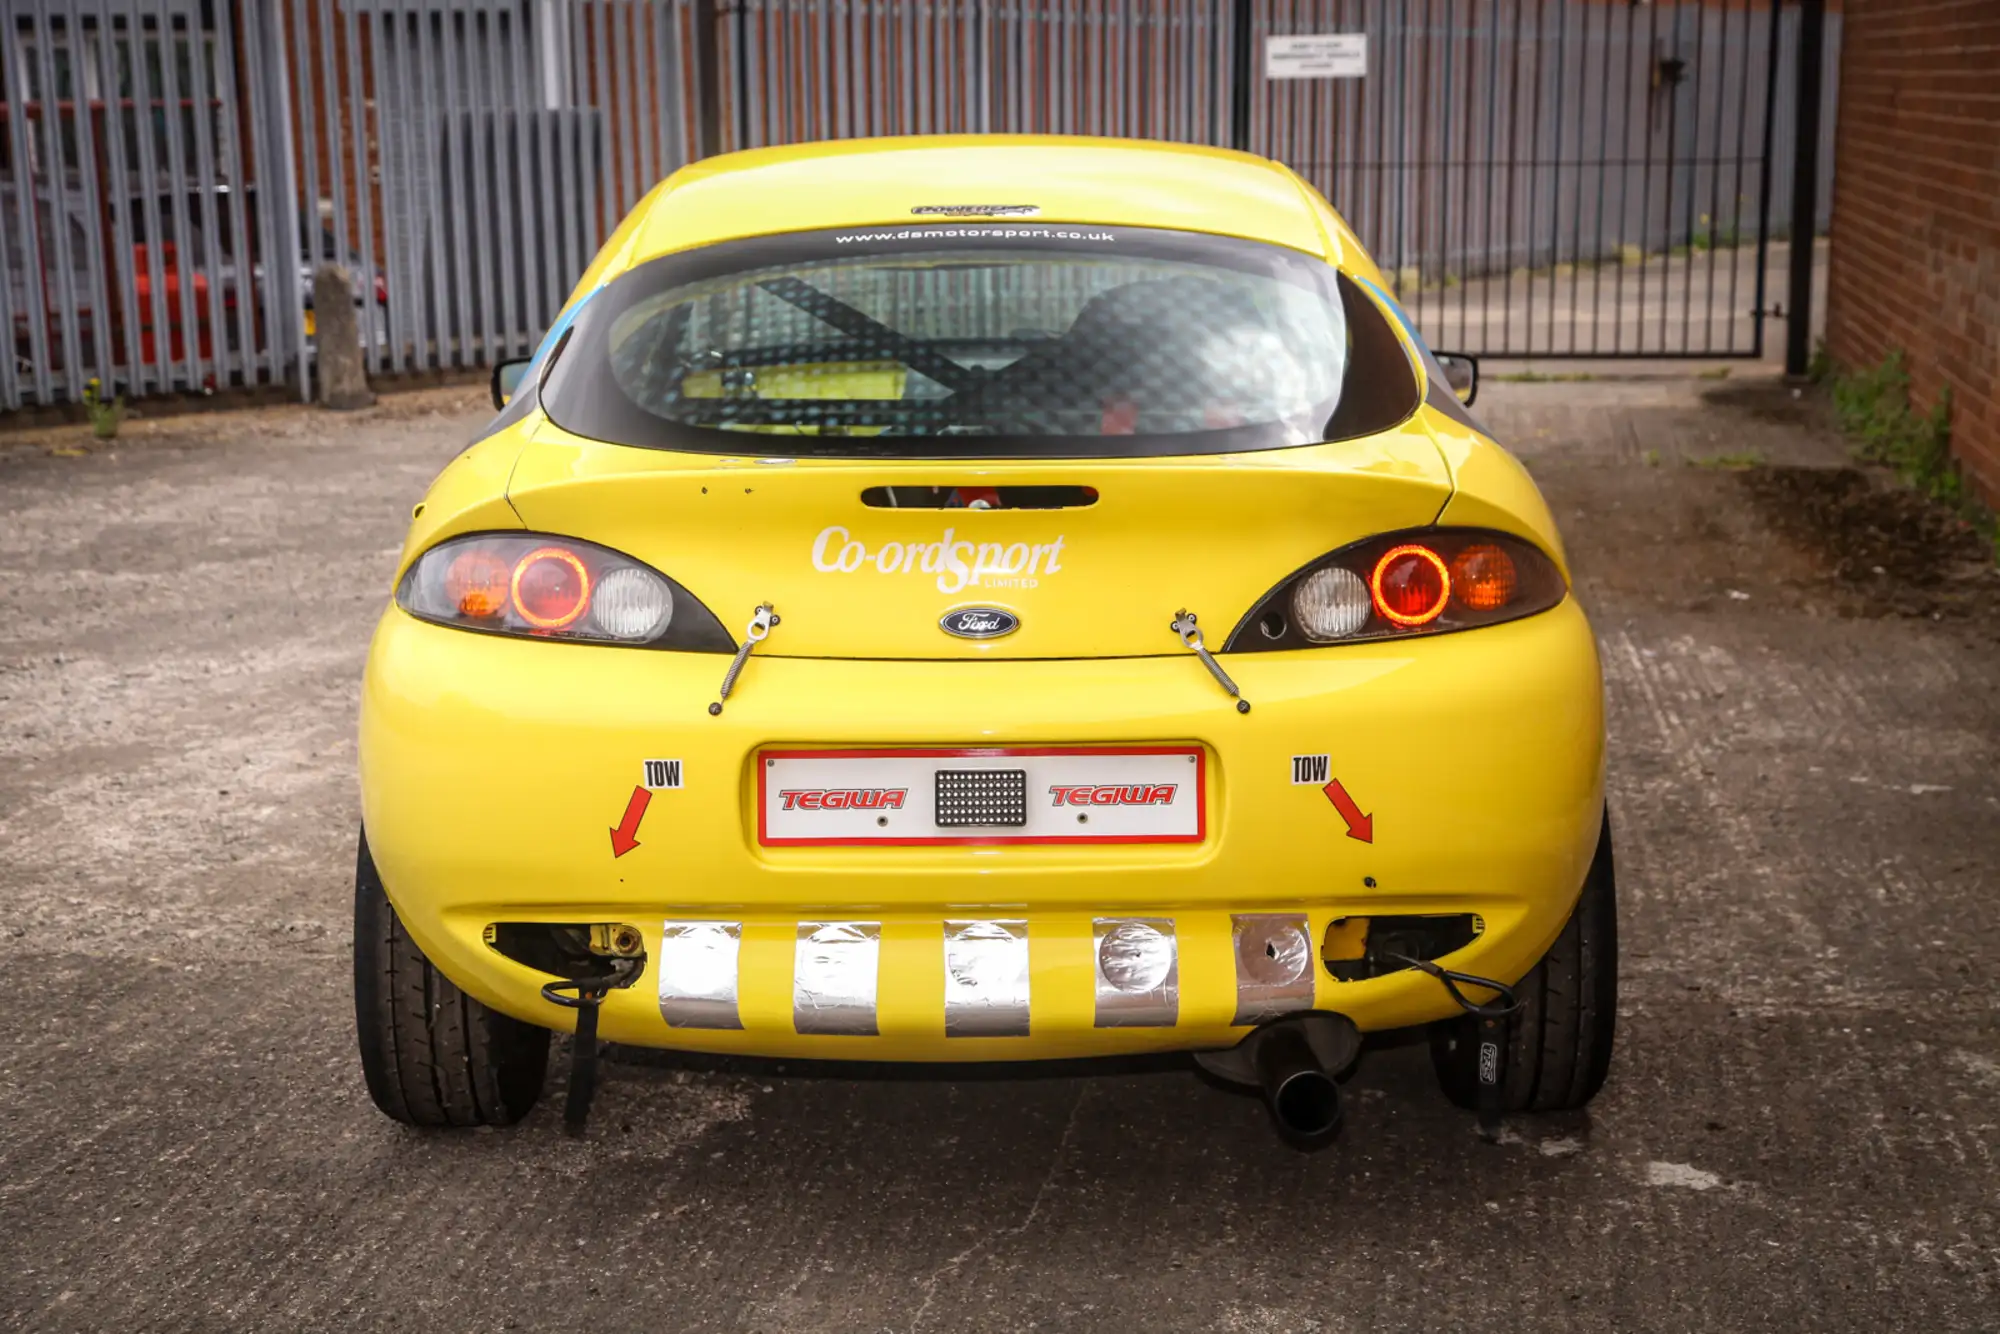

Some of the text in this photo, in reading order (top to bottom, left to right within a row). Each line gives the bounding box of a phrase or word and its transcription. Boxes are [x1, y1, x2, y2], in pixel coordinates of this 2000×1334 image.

[835, 229, 1115, 243] www.dsmotorsport.co.uk
[984, 577, 1039, 589] LIMITED
[957, 612, 1000, 632] Ford
[644, 760, 680, 787] TOW
[1292, 755, 1328, 783] TOW
[778, 787, 909, 811] TEGIWA
[1048, 783, 1179, 807] TEGIWA
